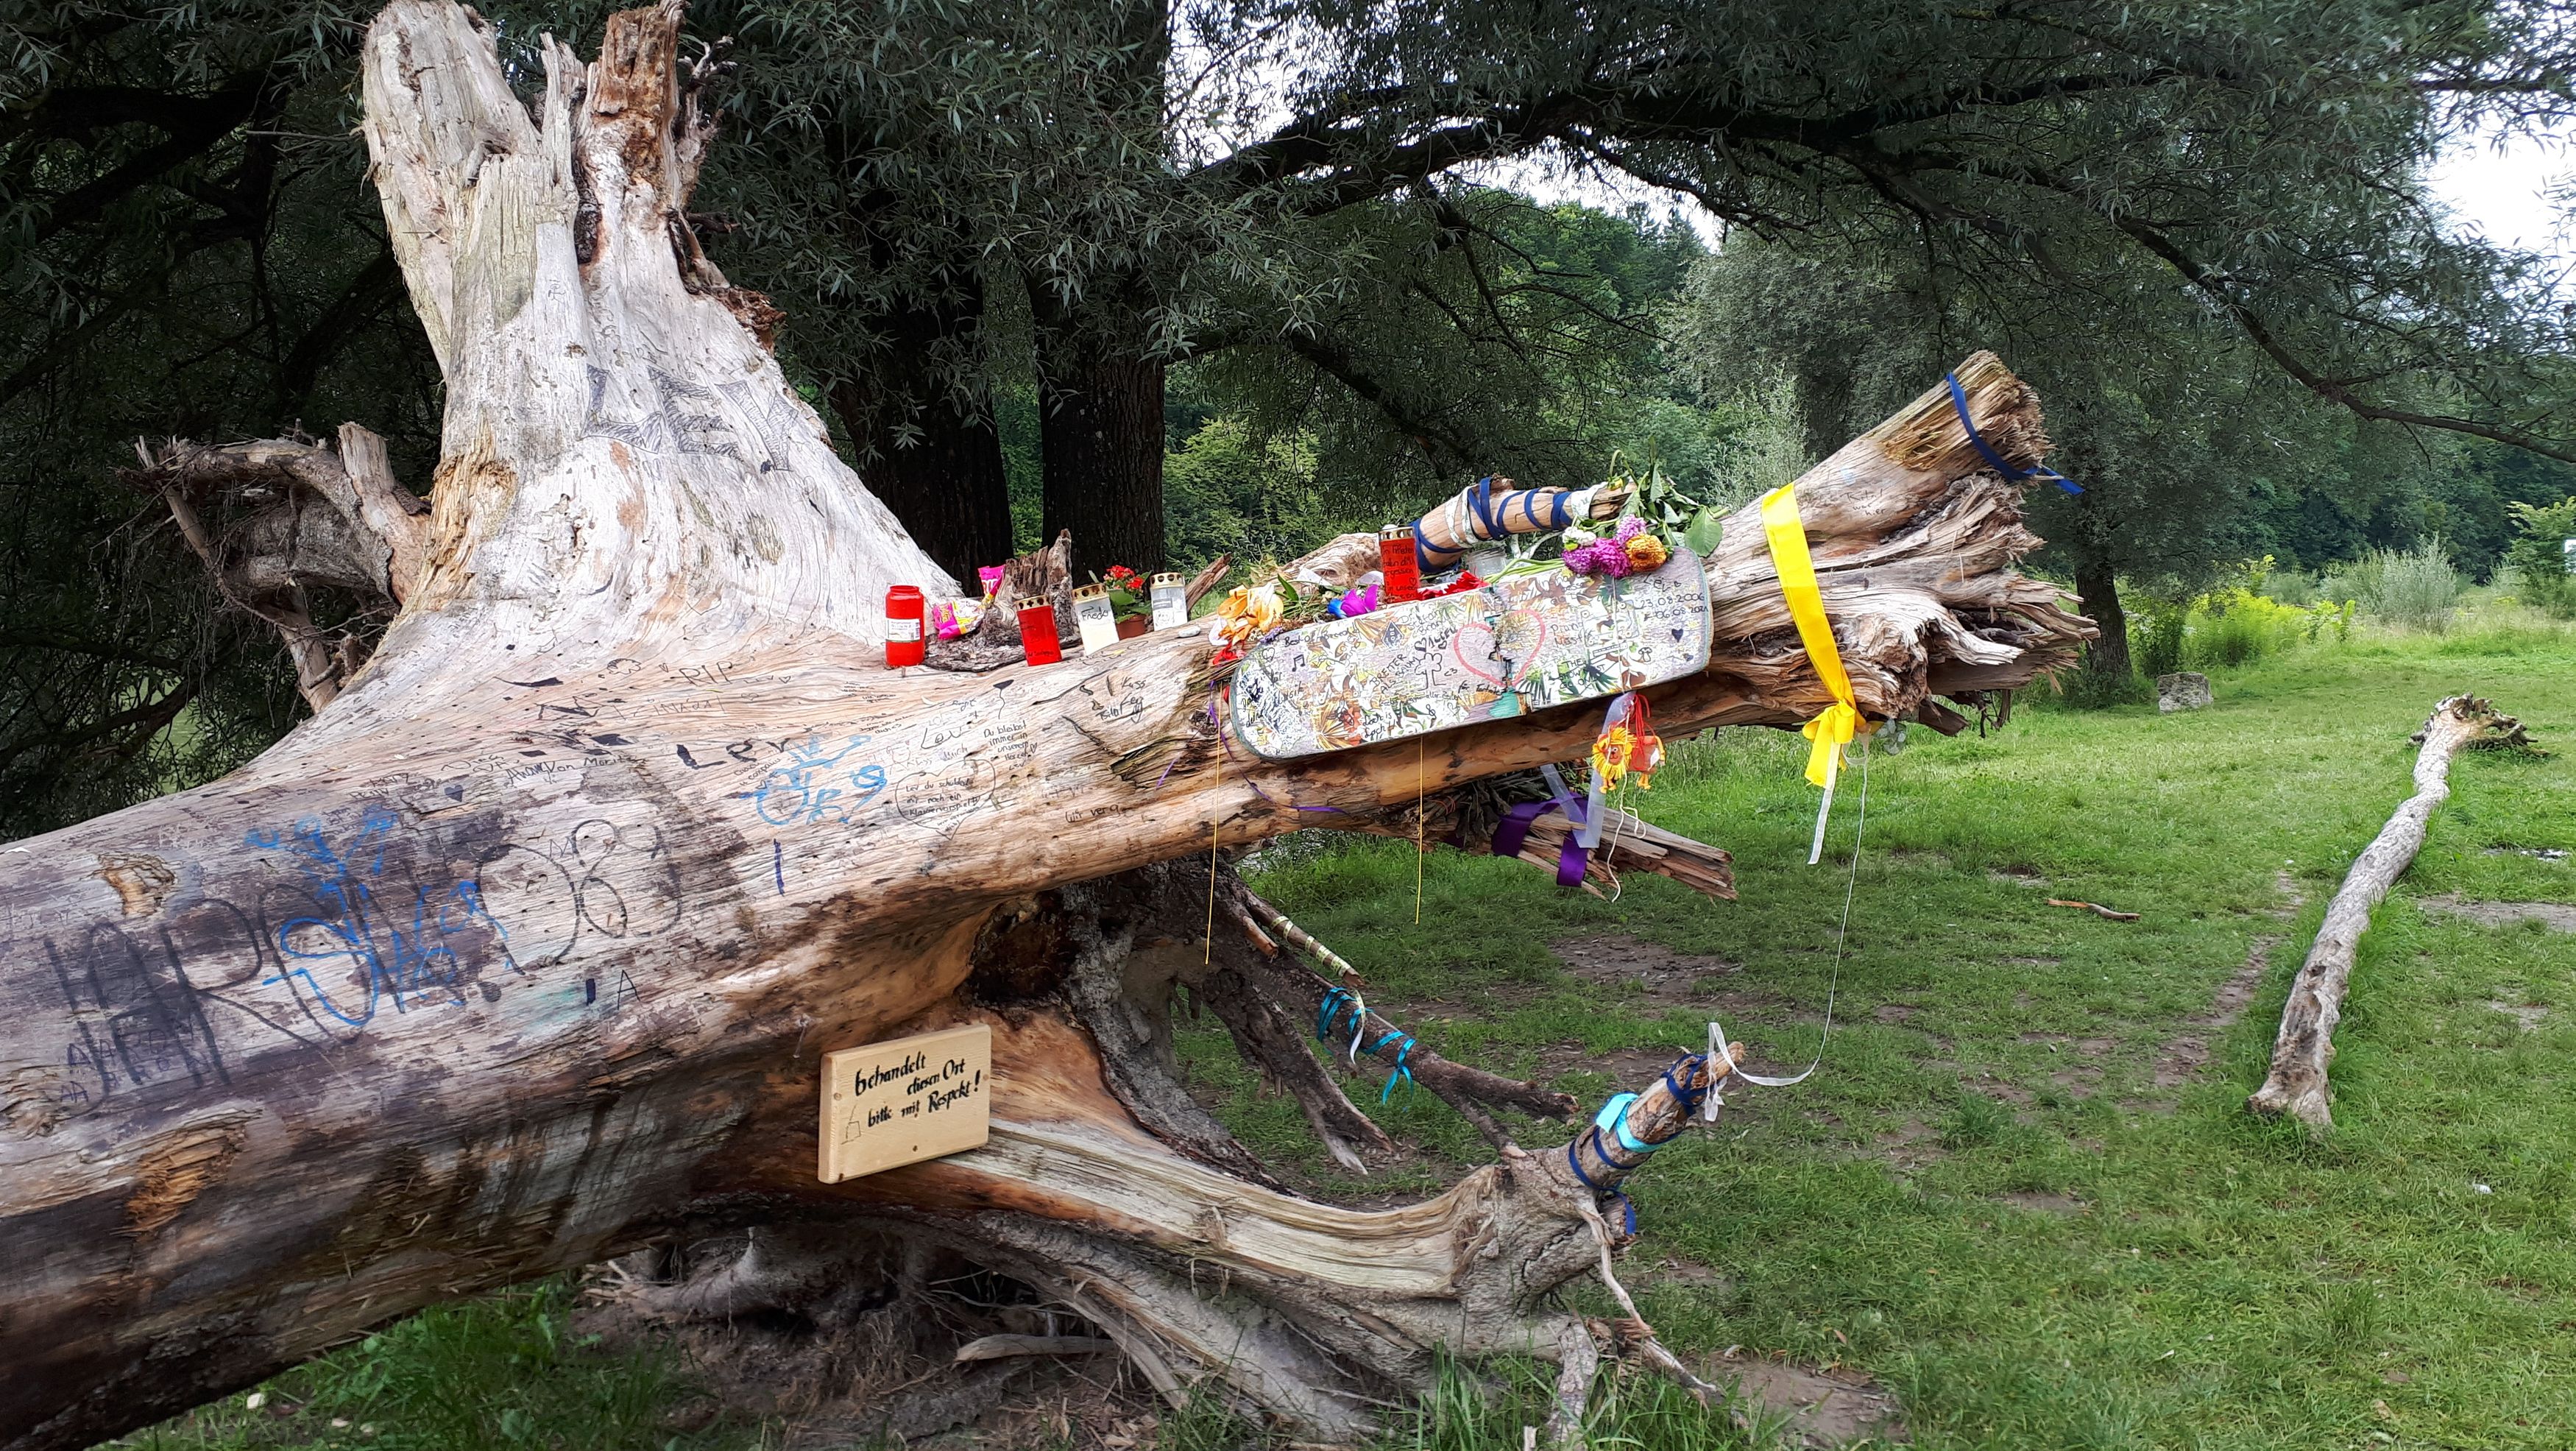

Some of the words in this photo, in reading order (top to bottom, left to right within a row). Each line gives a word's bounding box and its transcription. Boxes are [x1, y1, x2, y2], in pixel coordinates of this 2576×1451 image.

[679, 660, 733, 687] RIP
[855, 1051, 927, 1097] behandelt
[907, 1073, 940, 1096] diesen
[943, 1059, 966, 1080] Ort
[901, 1100, 920, 1118] mit
